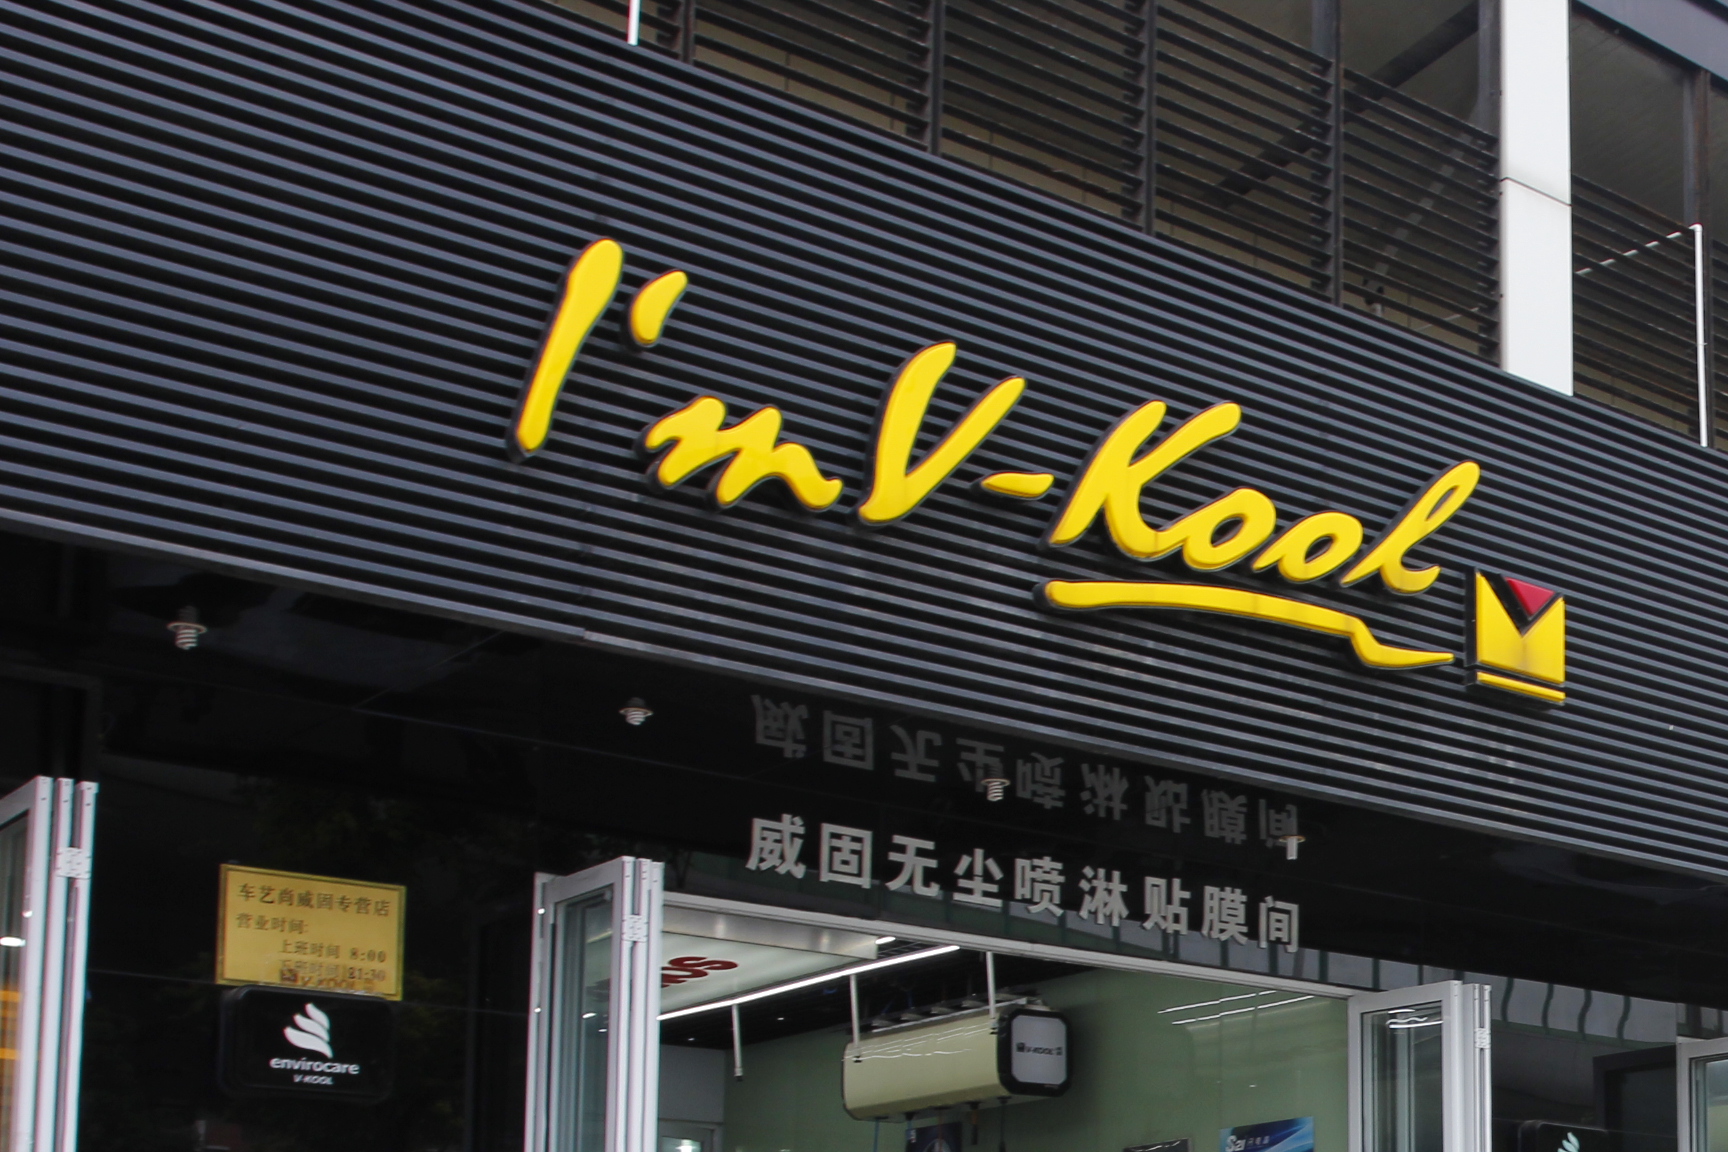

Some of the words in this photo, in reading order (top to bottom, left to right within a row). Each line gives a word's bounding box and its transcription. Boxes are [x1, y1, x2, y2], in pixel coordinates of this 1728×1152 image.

[746, 814, 1300, 954] 威固无尘喷淋贴膜间
[269, 1056, 360, 1075] envirocare
